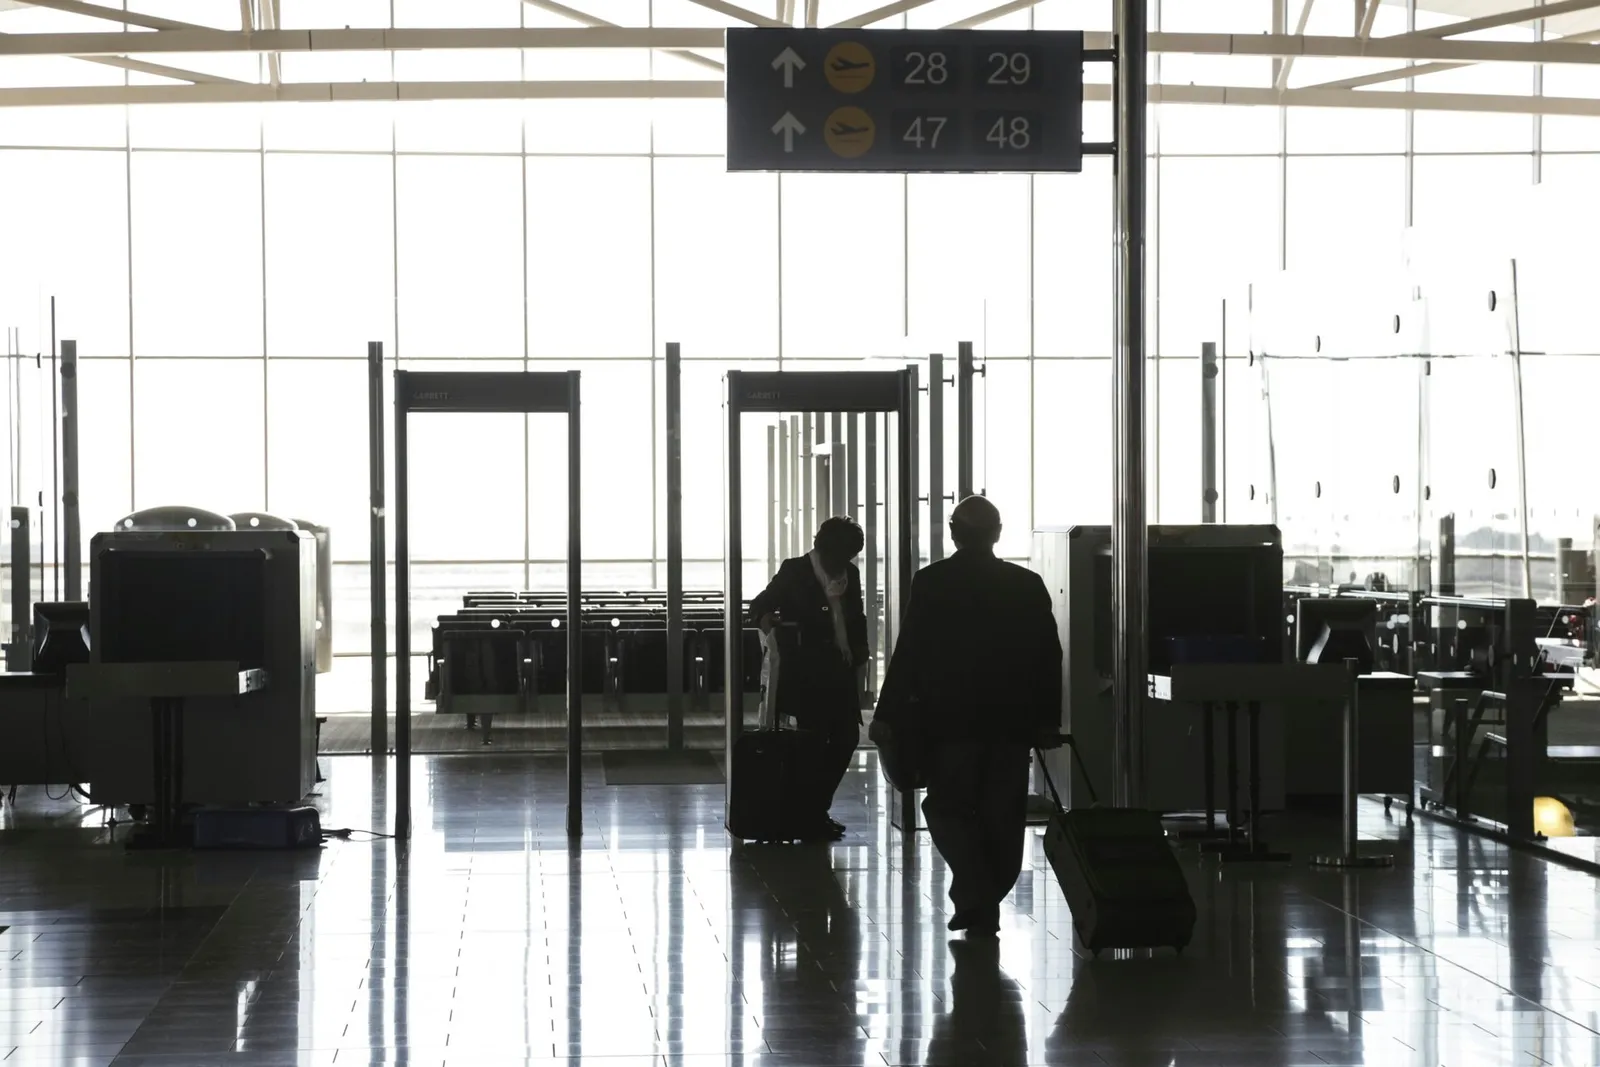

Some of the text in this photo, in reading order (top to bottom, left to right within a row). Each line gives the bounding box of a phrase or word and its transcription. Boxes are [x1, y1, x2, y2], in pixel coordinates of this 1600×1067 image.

[904, 52, 1031, 85] 28 29
[903, 117, 1030, 149] 47 48
